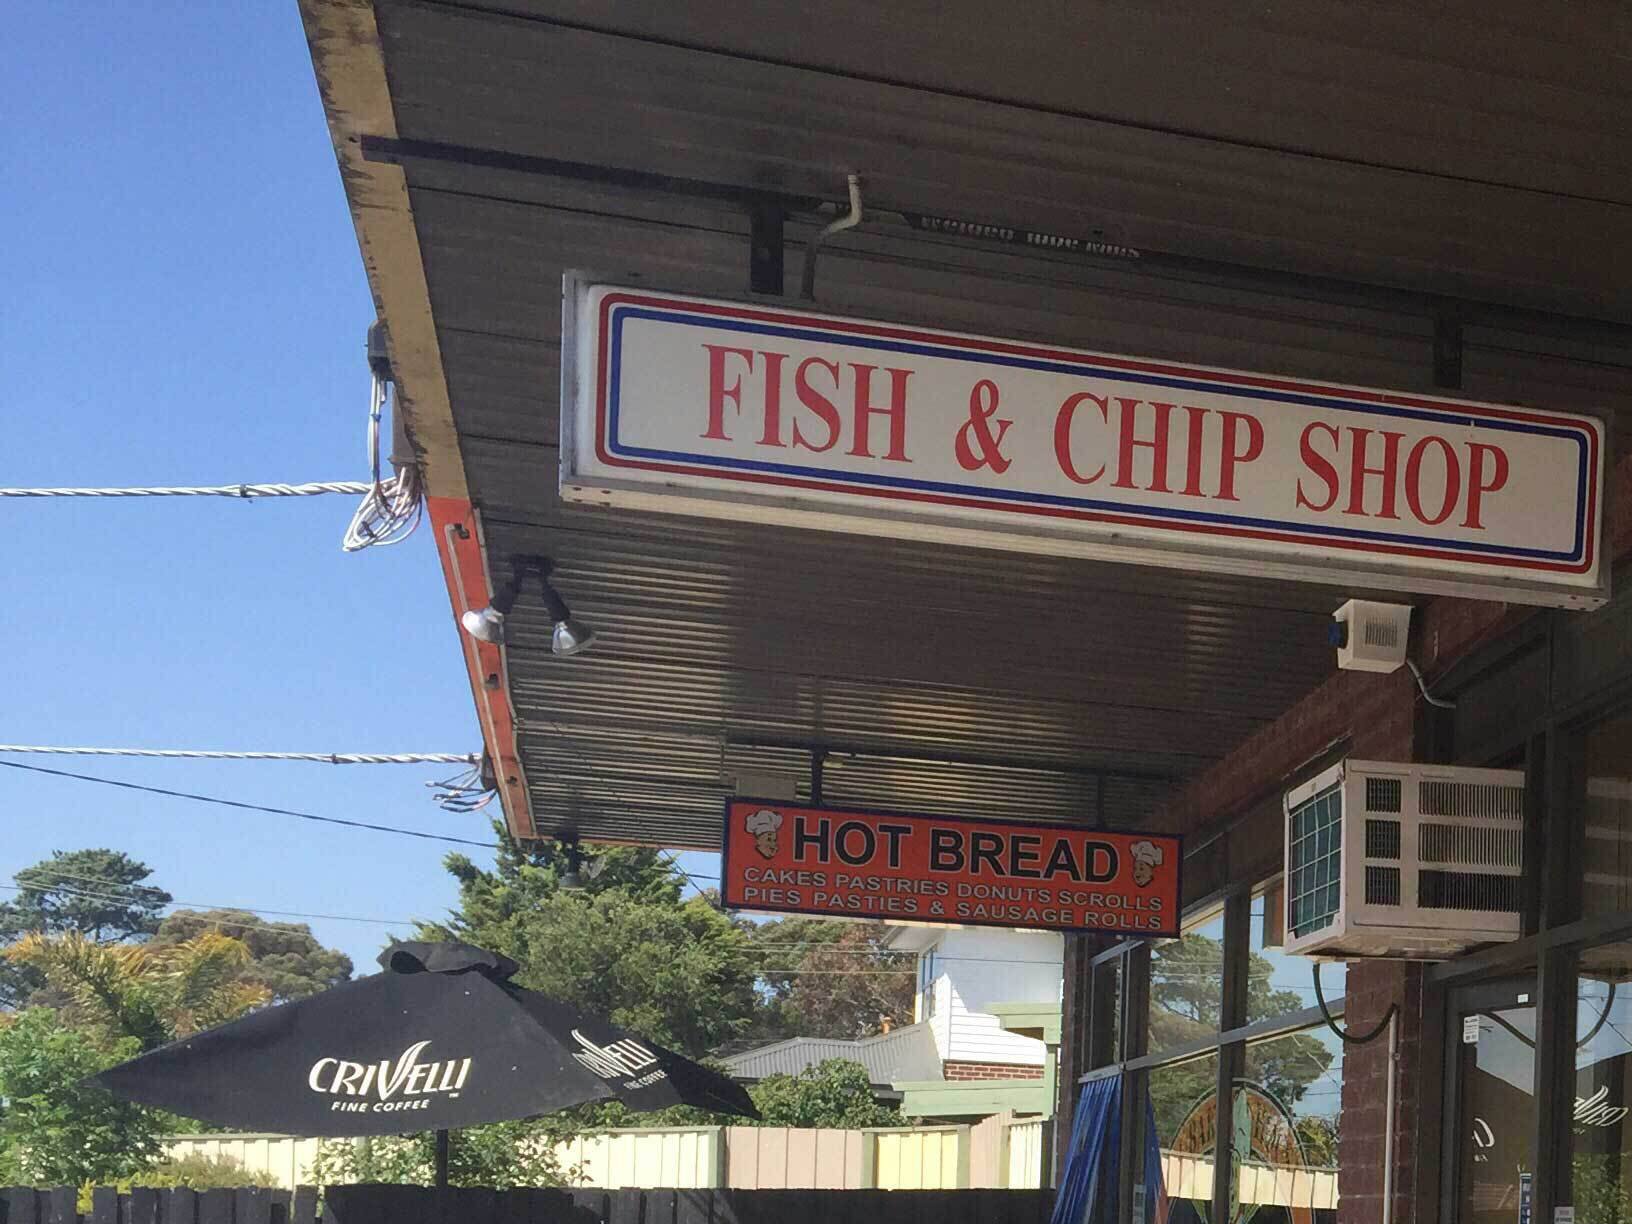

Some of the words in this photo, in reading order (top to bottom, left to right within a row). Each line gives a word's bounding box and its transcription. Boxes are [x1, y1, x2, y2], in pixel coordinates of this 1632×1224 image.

[700, 342, 914, 464] FISH
[954, 379, 1013, 475] &
[1053, 391, 1267, 503] CHIP
[1296, 421, 1510, 531] SHOP
[793, 815, 914, 869] HOT
[929, 826, 1120, 885] BREAD
[743, 866, 827, 888] CAKES
[835, 873, 949, 897] PASTRIES
[957, 882, 1051, 904] DONUTS
[1059, 889, 1163, 913] SCROLLS
[743, 887, 801, 906] PIES
[813, 891, 918, 915] PASTIES
[929, 901, 945, 917] &
[956, 901, 1074, 925] SAUSAGE
[1084, 910, 1163, 930] ROLLS
[308, 1040, 472, 1101] CRIVELLI
[332, 1101, 367, 1113] FINE
[373, 1099, 430, 1112] COFFEE
